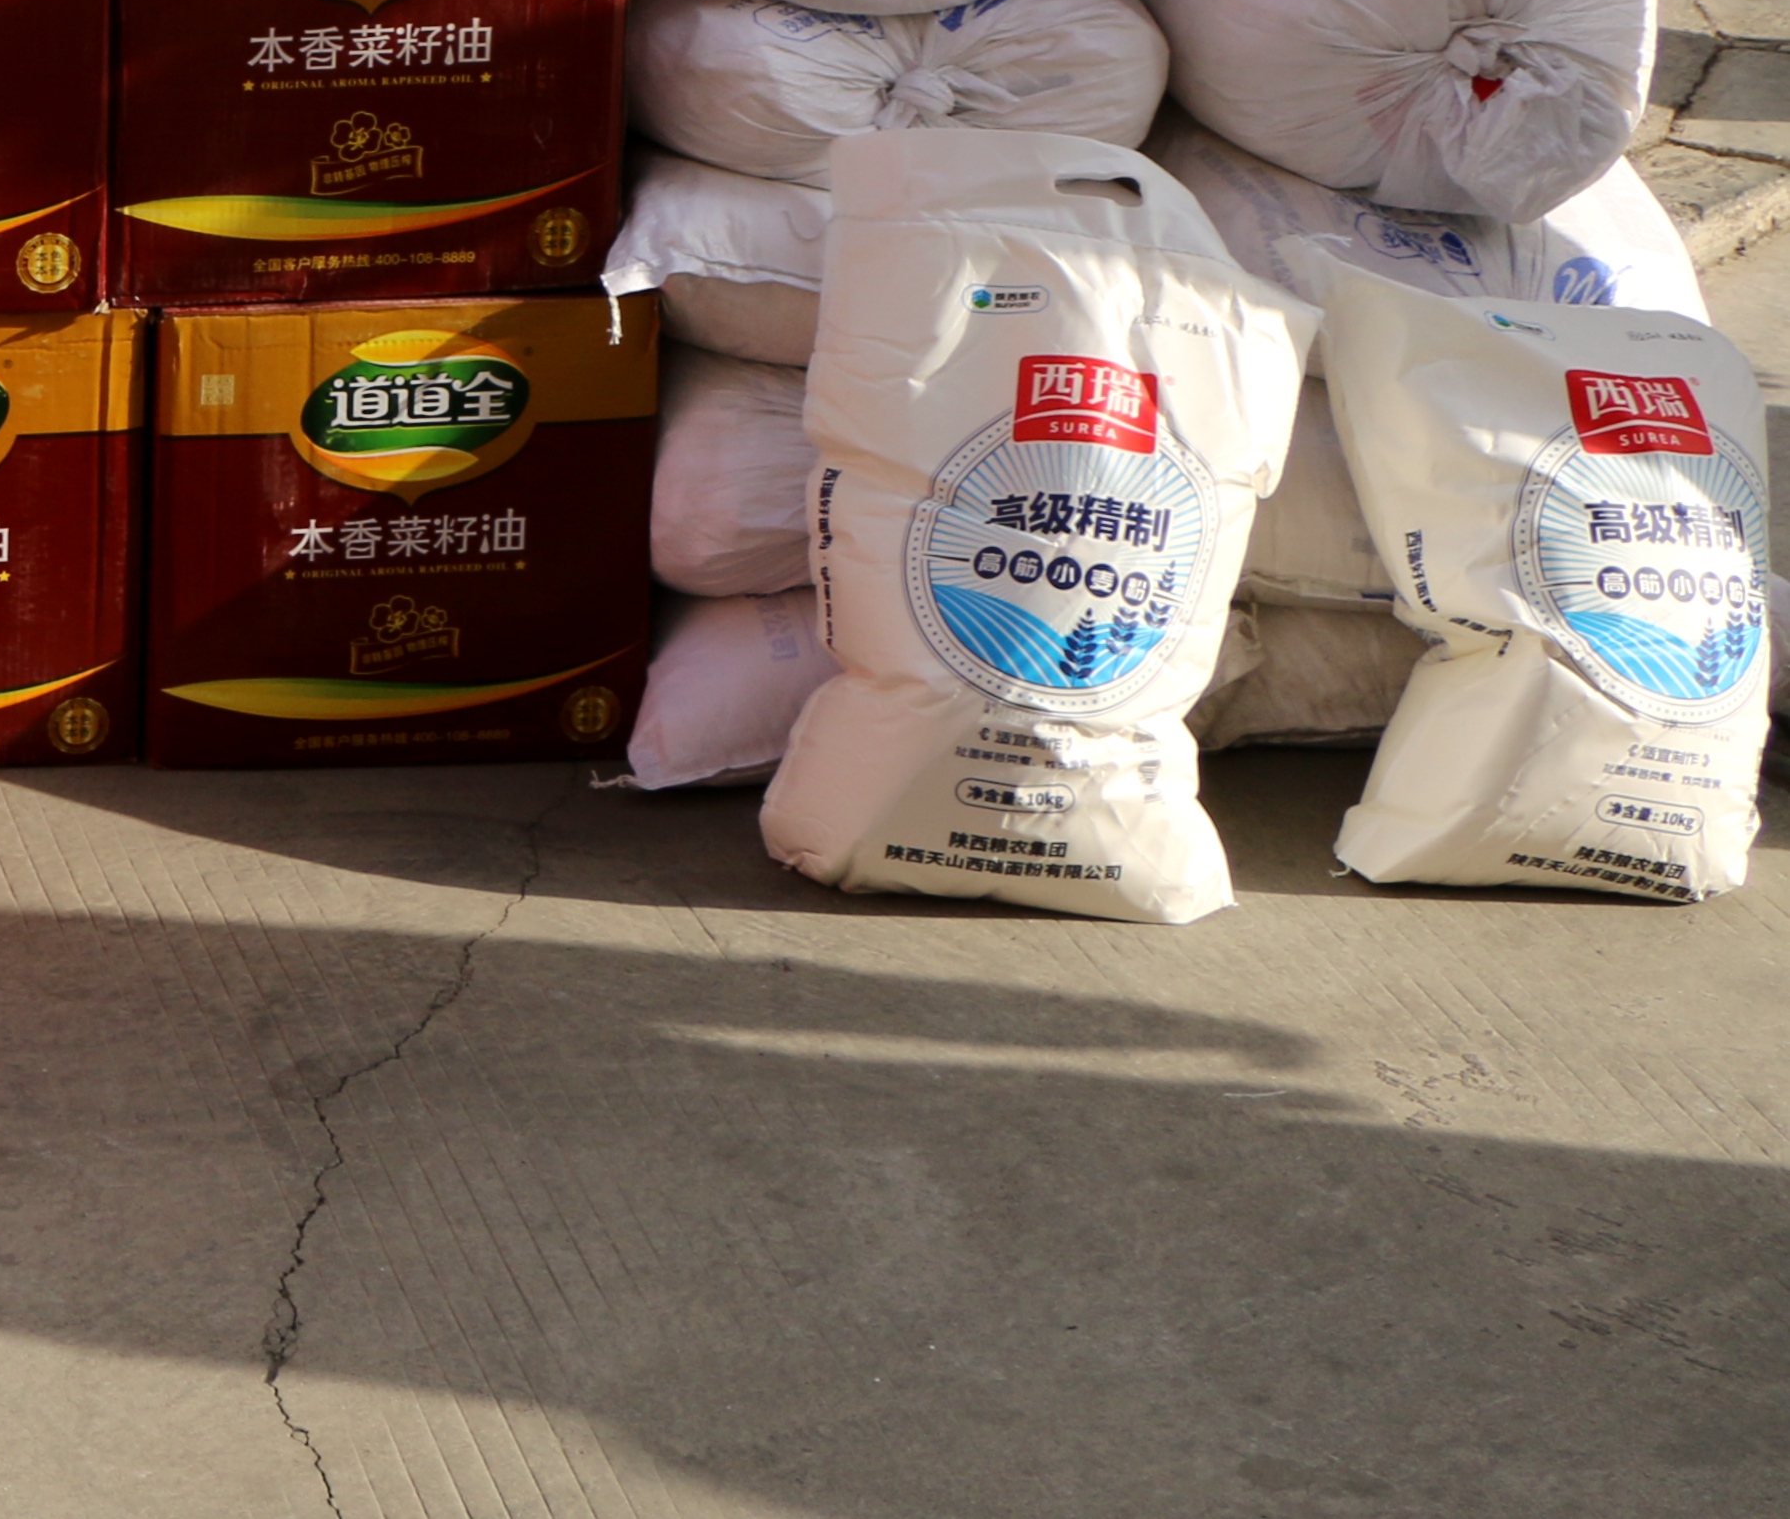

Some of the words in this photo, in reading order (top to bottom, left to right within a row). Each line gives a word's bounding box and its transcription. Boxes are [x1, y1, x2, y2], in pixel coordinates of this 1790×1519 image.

[247, 18, 494, 73] 本香菜籽油
[330, 371, 513, 429] 道道全
[1030, 363, 1142, 419] 西瑞
[1581, 378, 1689, 420] 西瑞
[1049, 420, 1117, 440] SUREA
[1619, 433, 1682, 447] SUREA
[290, 509, 526, 562] 本香菜籽油
[985, 491, 1171, 552] 高级精制
[1584, 501, 1747, 552] 高级精制
[975, 546, 1151, 603] 高筋小麦粉
[1600, 571, 1746, 607] 高筋小麦粉
[884, 844, 1122, 883] 陕西天山西瑞面粉有限公司
[950, 831, 1068, 859] 陕西粮农集团
